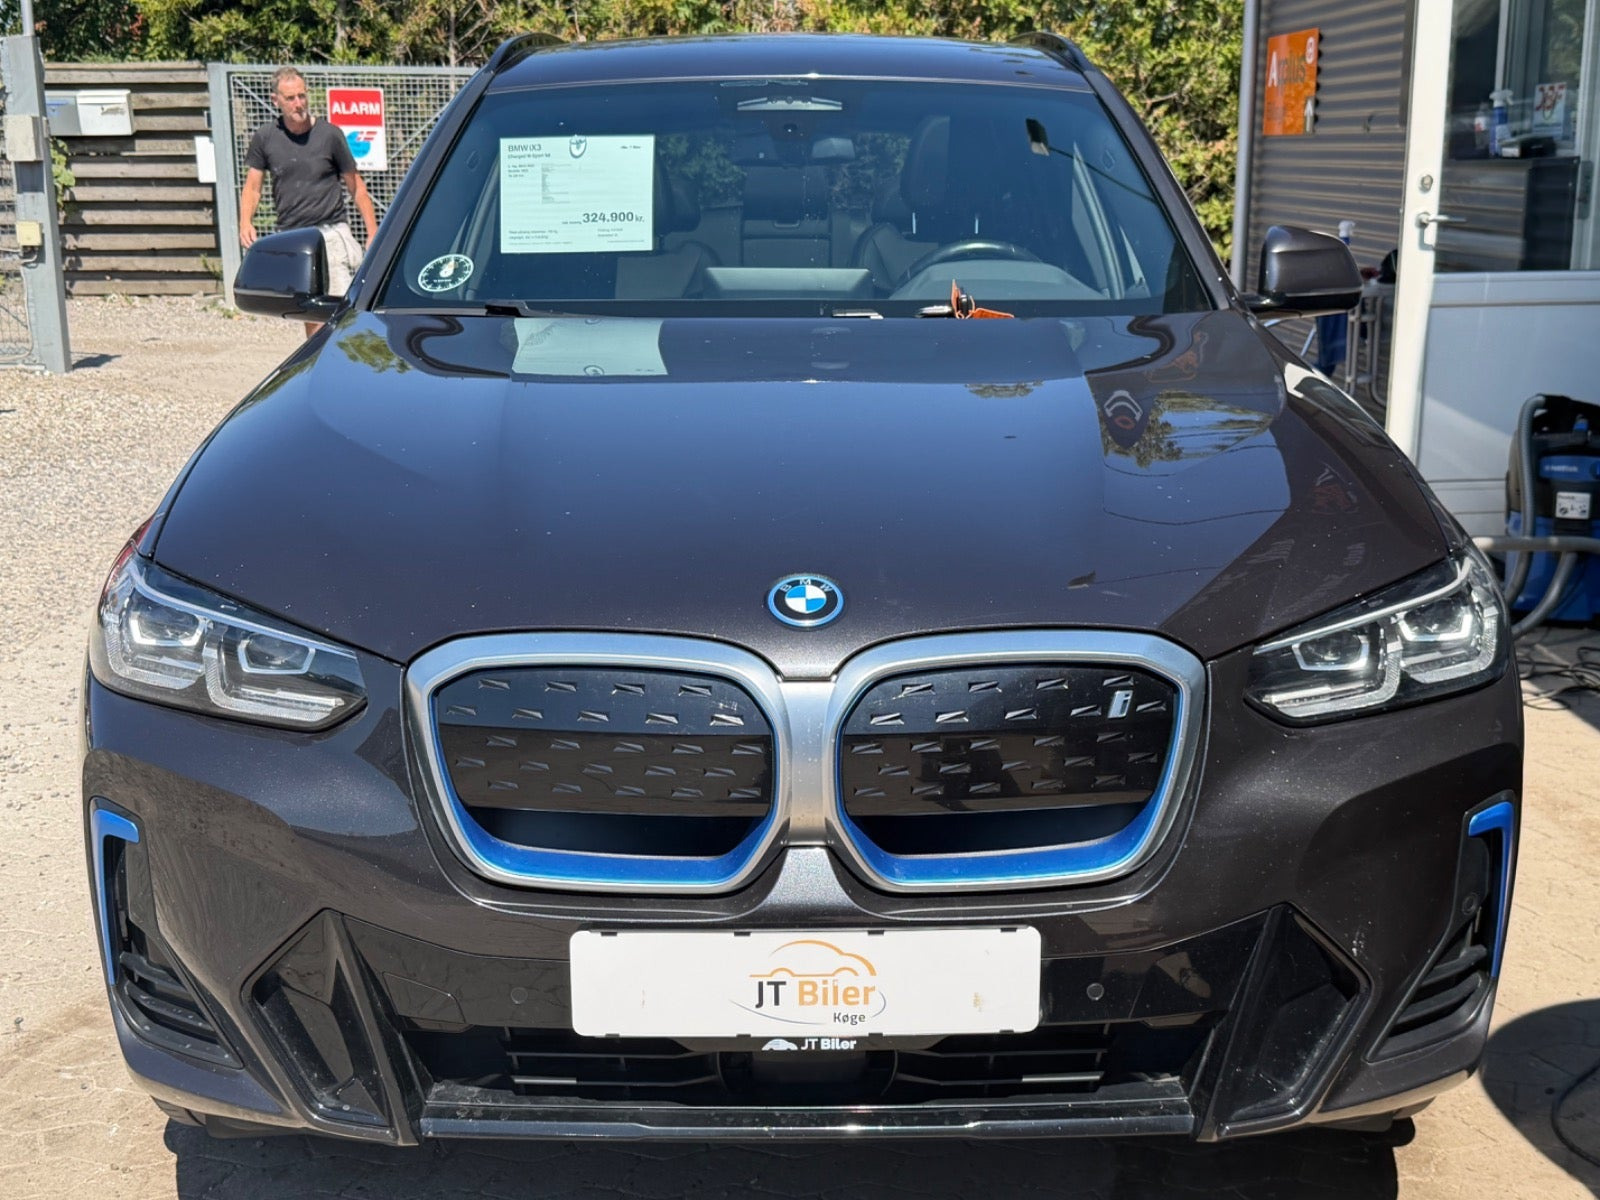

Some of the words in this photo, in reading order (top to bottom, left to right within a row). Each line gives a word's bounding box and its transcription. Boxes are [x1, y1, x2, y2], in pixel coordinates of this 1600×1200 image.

[332, 101, 380, 115] ALARM
[508, 144, 528, 152] BMW
[582, 212, 634, 223] 324.900
[635, 214, 645, 222] kr.
[780, 578, 833, 592] BMW
[755, 981, 787, 1009] JT
[798, 979, 876, 1006] Biler
[833, 1011, 866, 1026] Køge
[800, 1038, 819, 1050] JT
[820, 1037, 857, 1050] Biler
